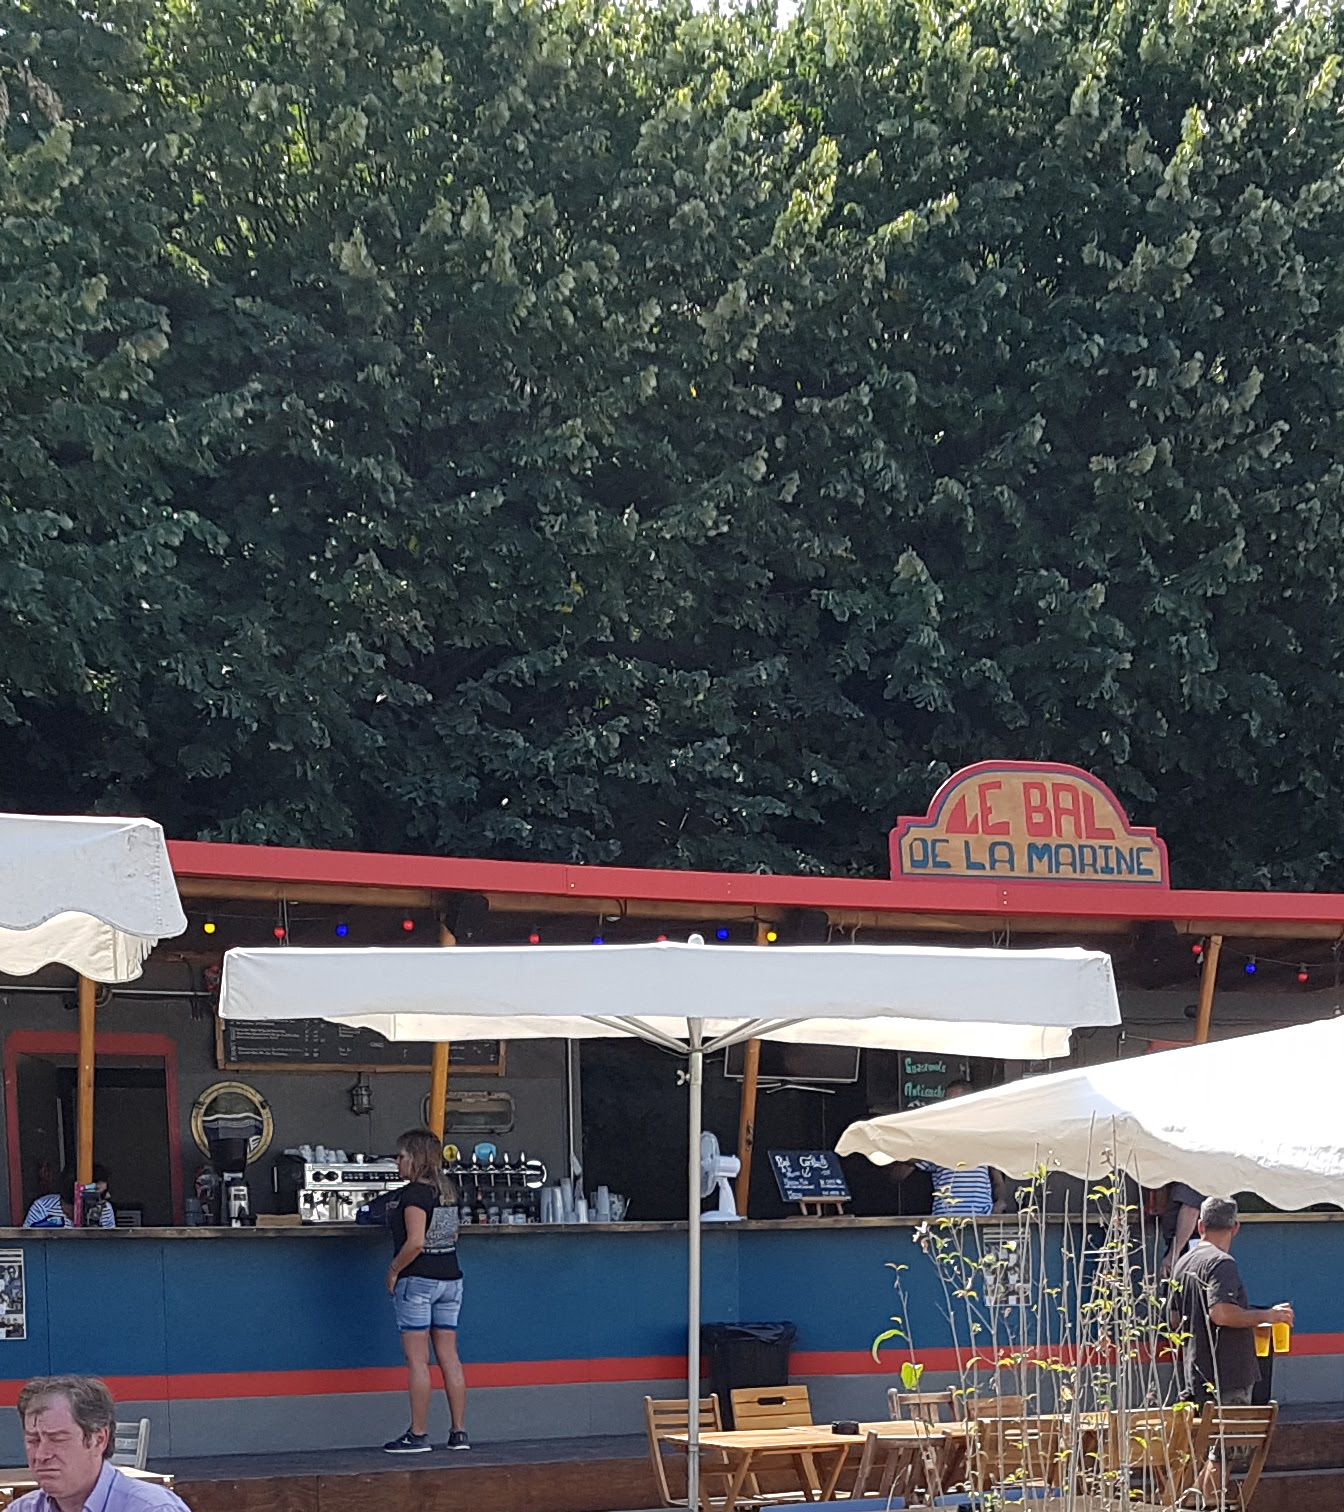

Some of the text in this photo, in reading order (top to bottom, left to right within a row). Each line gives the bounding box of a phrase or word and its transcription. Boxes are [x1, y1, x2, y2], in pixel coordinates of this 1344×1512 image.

[945, 780, 1116, 840] LE BAL
[908, 837, 1154, 876] DE LA MARINE
